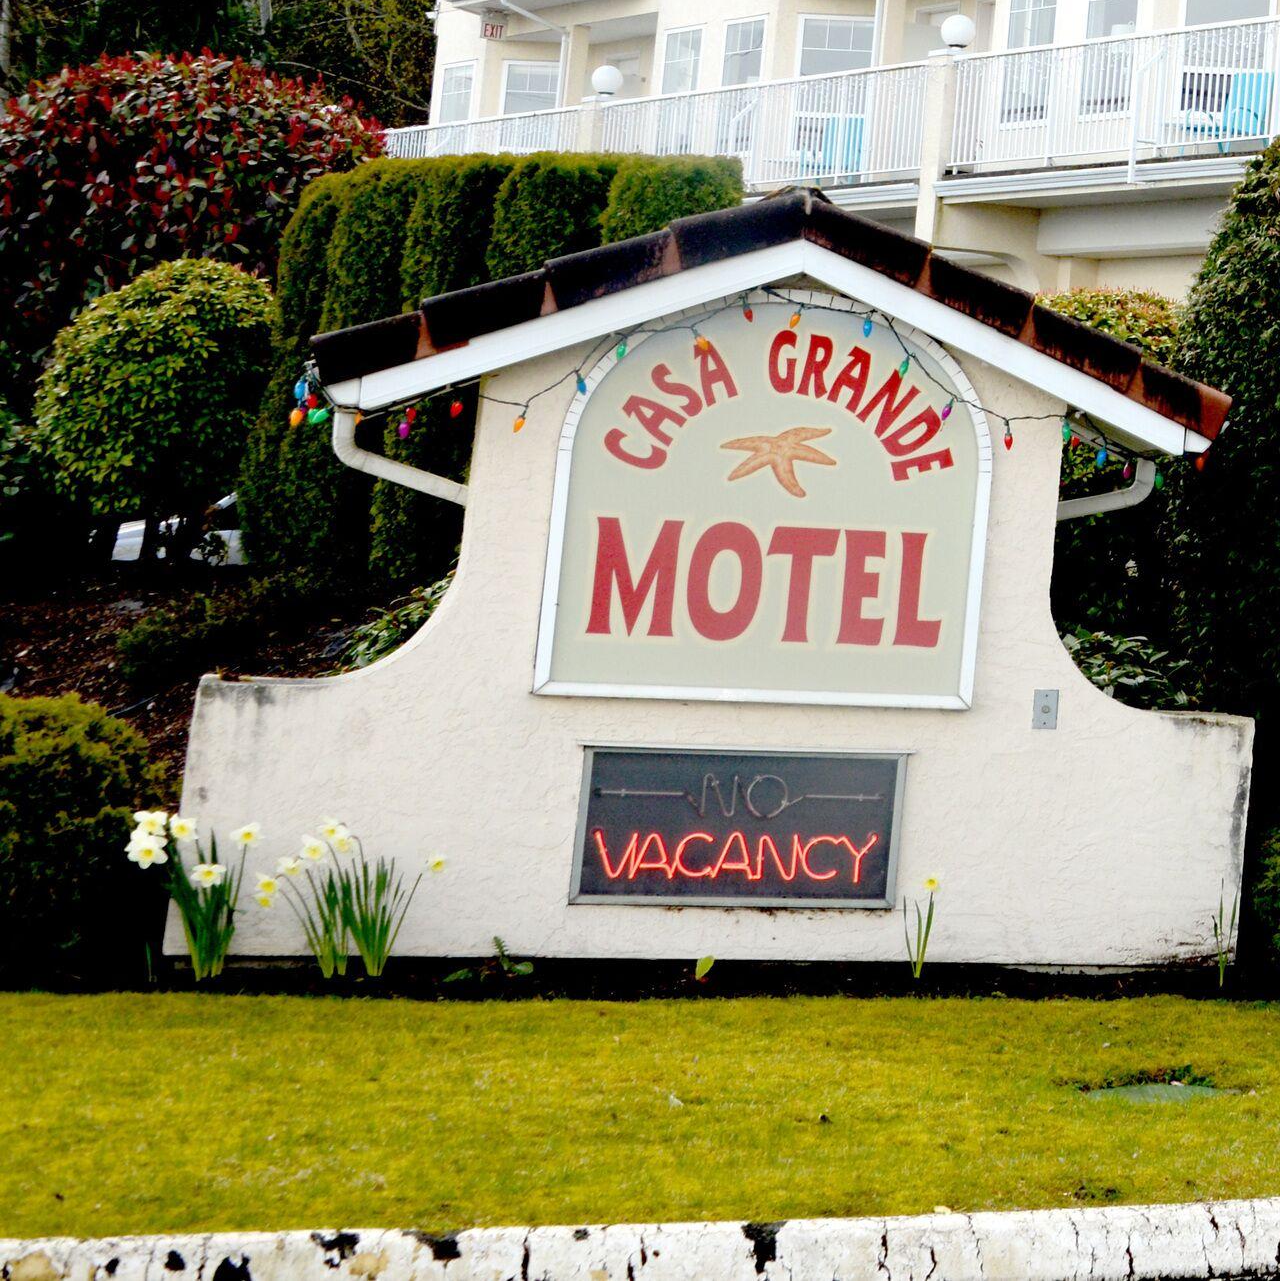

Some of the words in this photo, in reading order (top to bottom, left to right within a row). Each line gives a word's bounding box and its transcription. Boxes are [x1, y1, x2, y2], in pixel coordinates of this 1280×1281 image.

[484, 23, 504, 39] EXIT
[603, 342, 738, 470] CASA
[768, 329, 955, 482] GRANDE
[585, 516, 943, 648] MOTEL
[699, 772, 790, 818] NO
[593, 829, 880, 884] VACANCY
